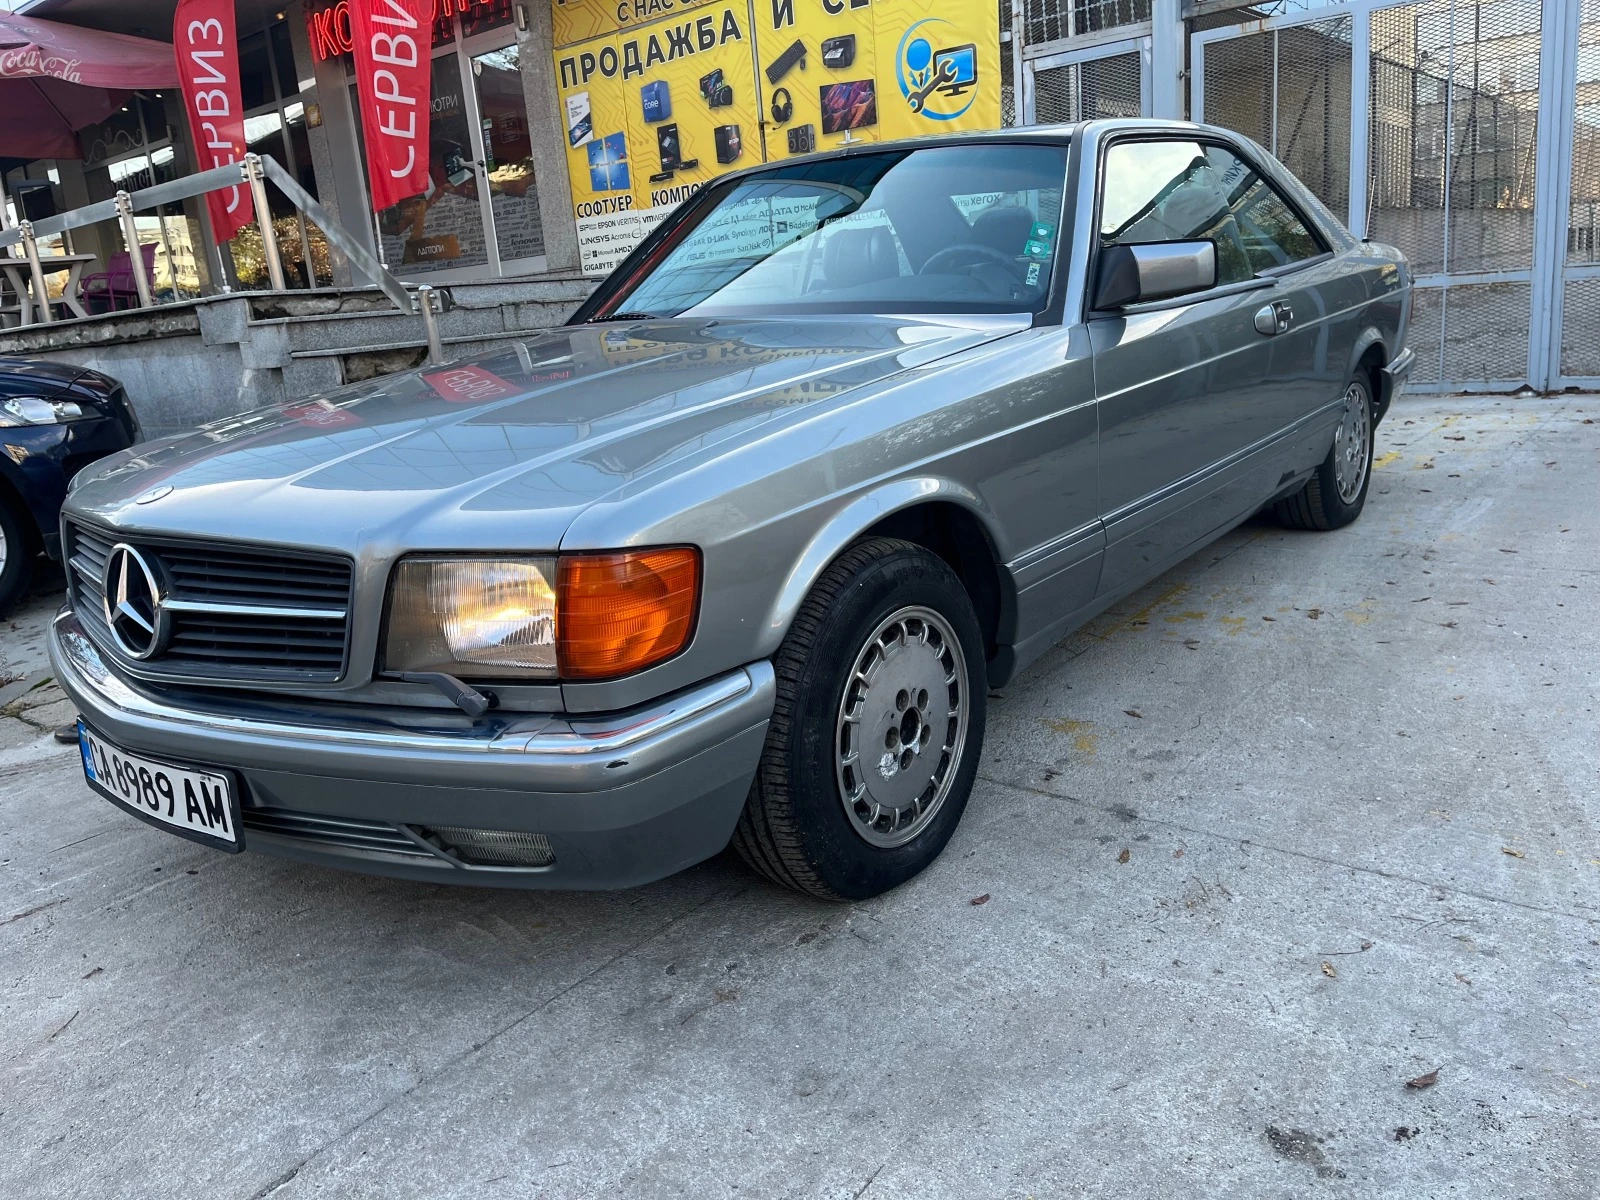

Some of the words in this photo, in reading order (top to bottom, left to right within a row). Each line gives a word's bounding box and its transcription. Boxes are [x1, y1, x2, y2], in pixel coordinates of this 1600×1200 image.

[616, 2, 630, 22] С
[558, 8, 743, 89] ПРОДАЖБА
[771, 0, 795, 30] И
[576, 194, 633, 219] СОФТУЕР
[970, 194, 1001, 206] xerox
[758, 206, 793, 219] ADATA
[597, 219, 617, 230] EPSON
[580, 234, 611, 247] LINKSYS
[706, 232, 731, 244] D-Link
[583, 261, 614, 272] GIGABYTE
